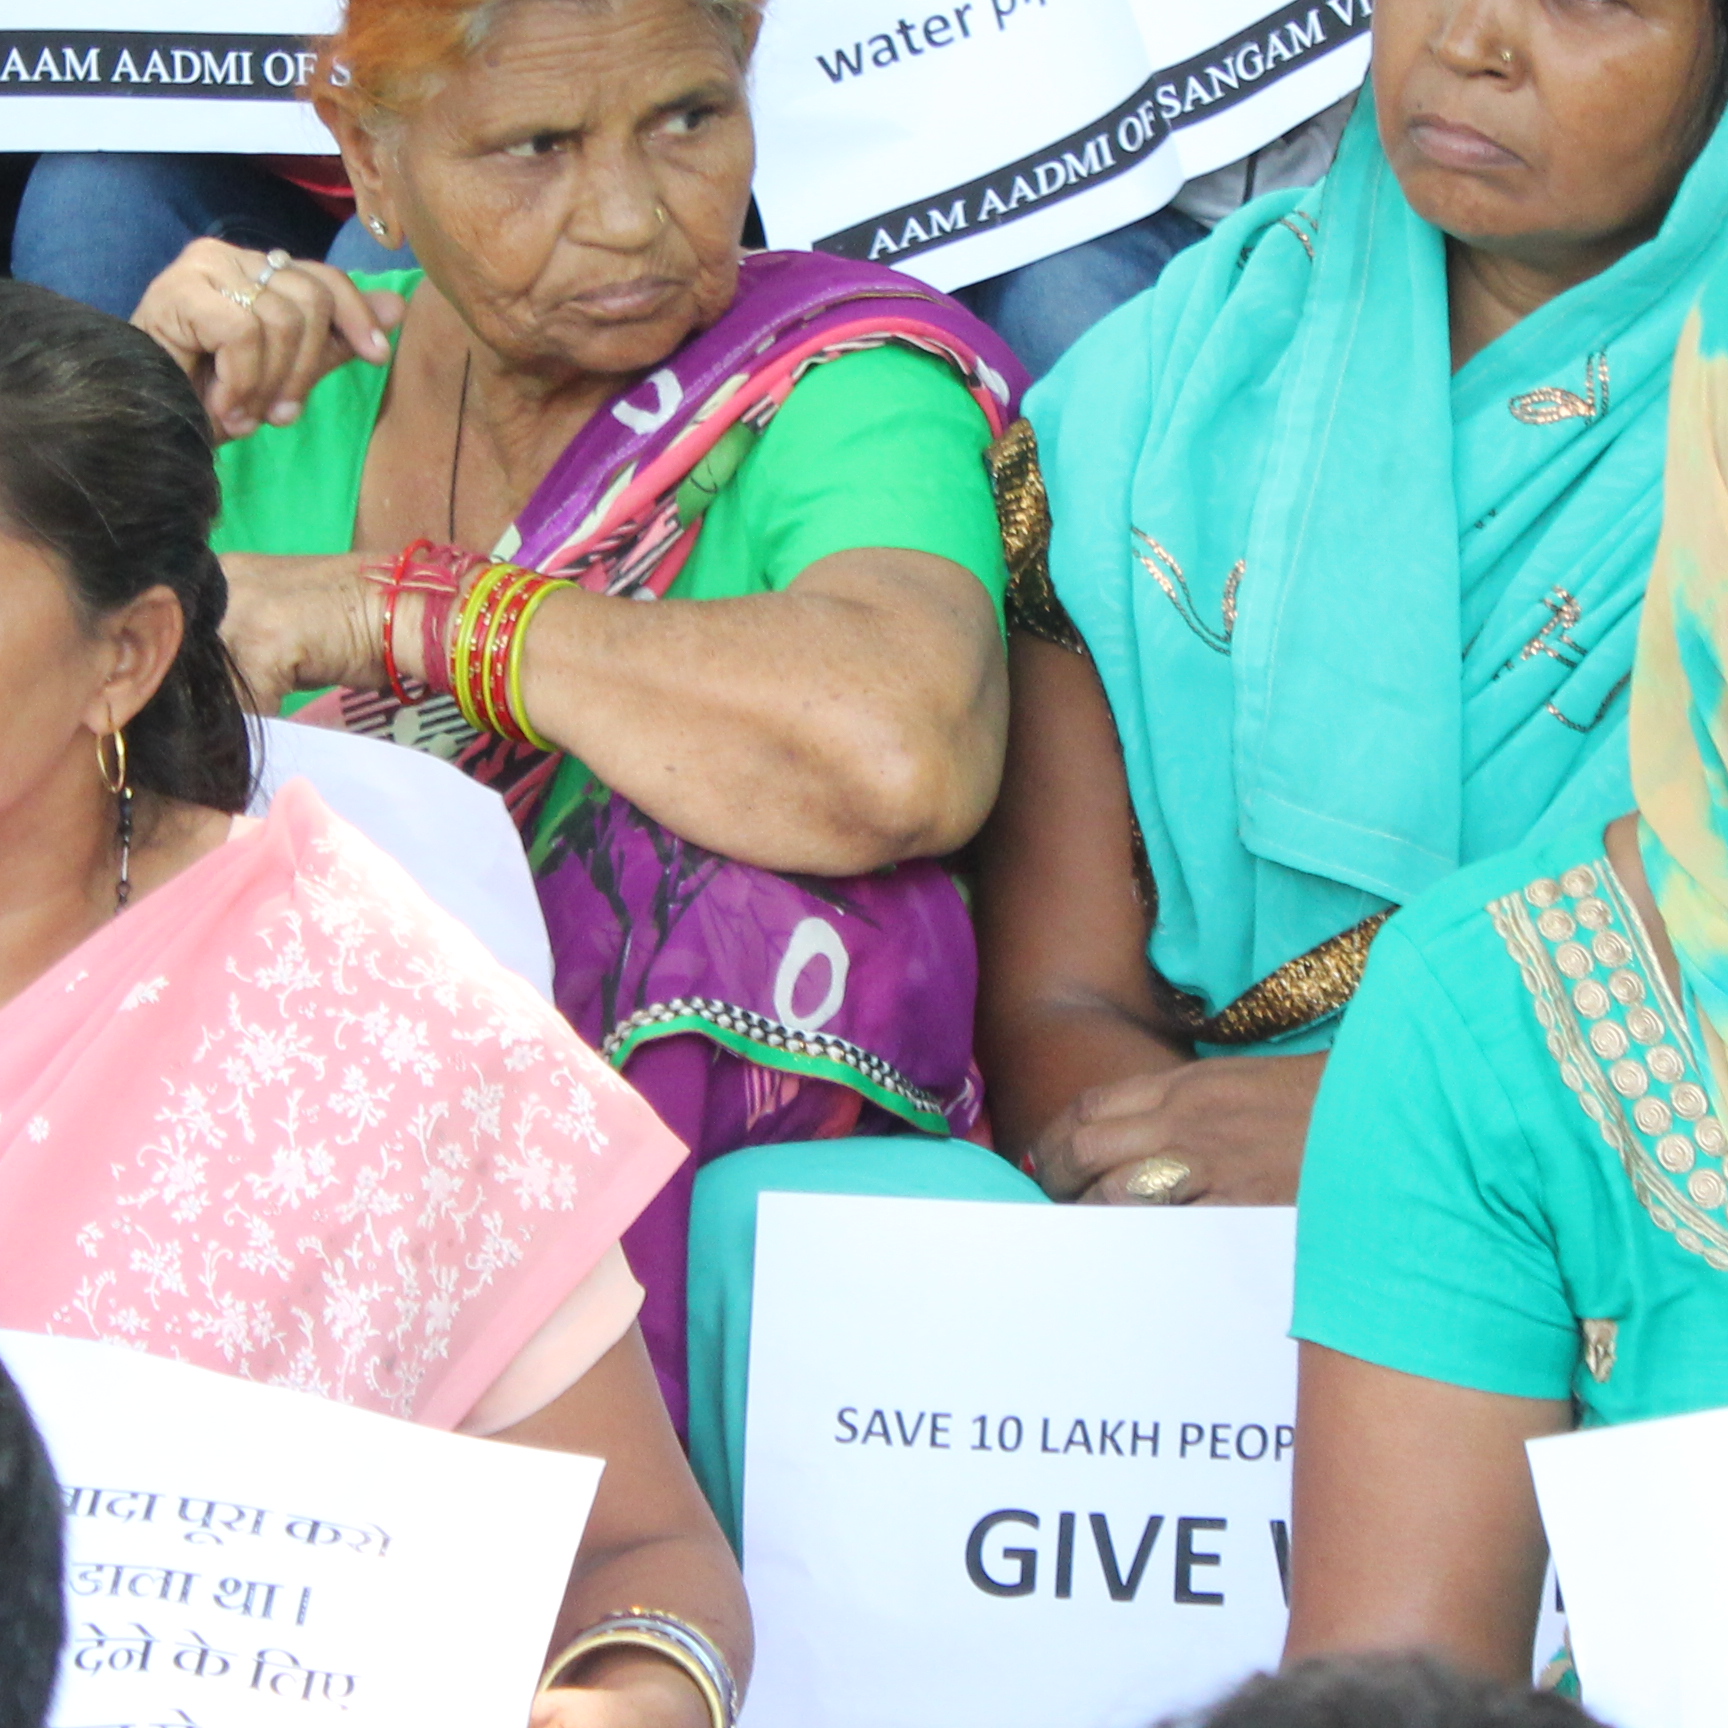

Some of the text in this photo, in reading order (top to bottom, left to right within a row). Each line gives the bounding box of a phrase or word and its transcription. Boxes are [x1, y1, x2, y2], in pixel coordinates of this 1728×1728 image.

[111, 48, 254, 87] AADMI
[262, 52, 319, 88] OF
[815, 0, 974, 85] water
[868, 15, 1328, 261] AAM AADMI OF SANGAM
[834, 1405, 1297, 1462] SAVE 10 LAKH PEOP
[177, 1495, 271, 1547] पूरा
[284, 1512, 393, 1559] करो
[964, 1507, 1228, 1607] GIVE
[69, 1561, 285, 1621] डाला था
[73, 1622, 361, 1711] देने के लिए
